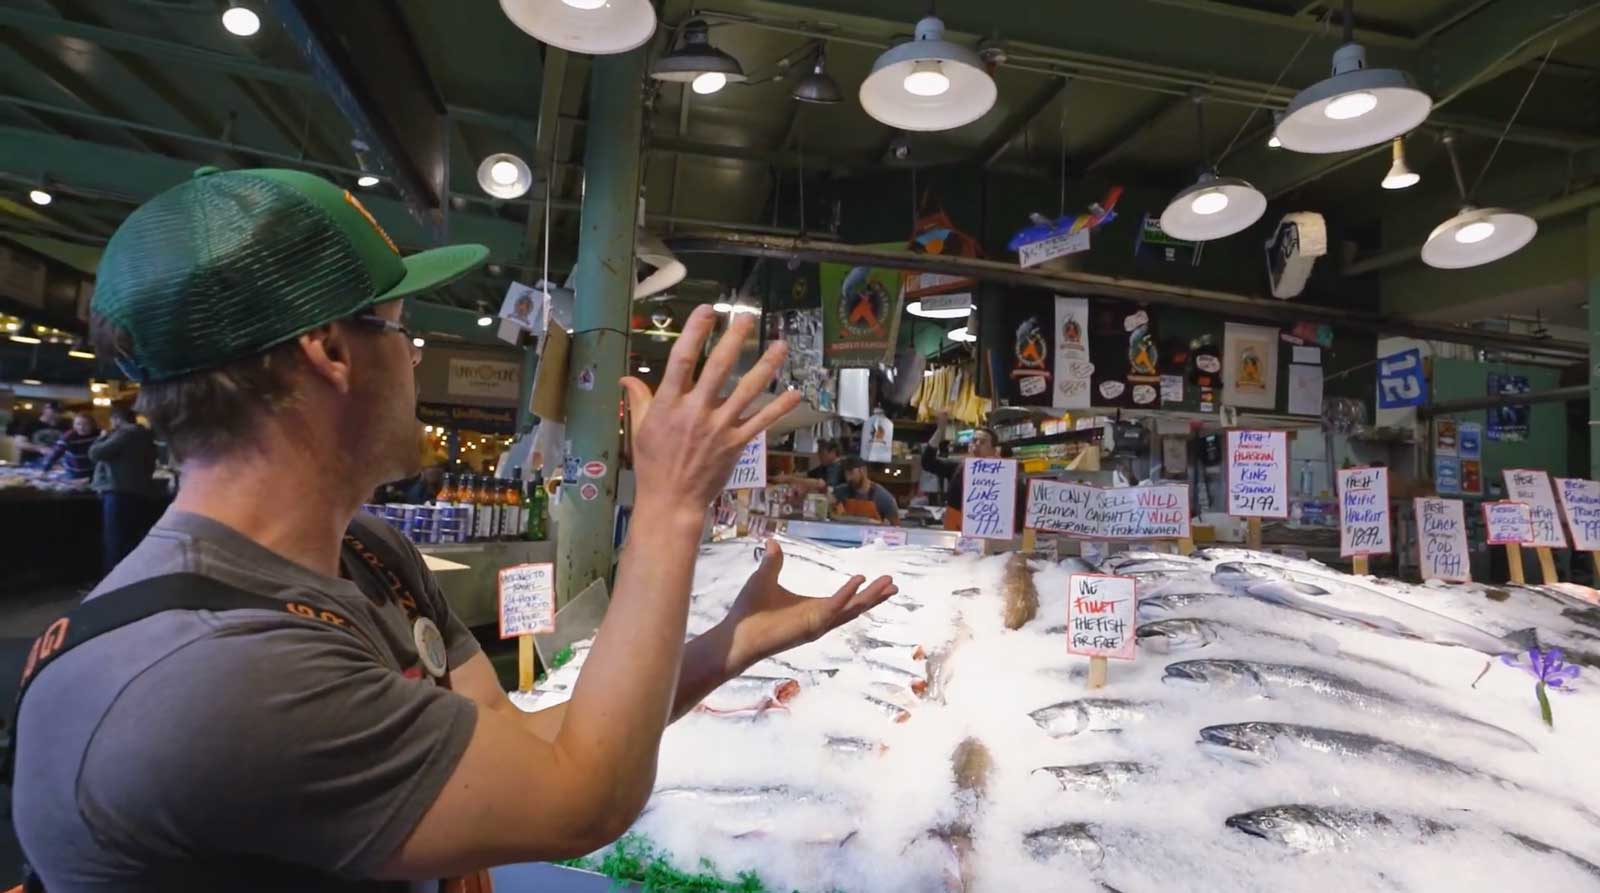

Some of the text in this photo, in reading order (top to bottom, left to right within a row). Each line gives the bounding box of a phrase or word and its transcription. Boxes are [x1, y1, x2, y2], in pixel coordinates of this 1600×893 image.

[1381, 355, 1421, 402] 12
[970, 460, 1006, 474] FRESH
[1240, 468, 1268, 481] KING
[967, 486, 1000, 502] LING
[1033, 483, 1177, 509] WE ONLY SELL WILD
[1231, 483, 1276, 494] SALMON
[1344, 491, 1376, 506] PACIFIC
[973, 502, 999, 515] COD
[1029, 504, 1078, 518] SALMON
[1085, 508, 1130, 522] CAUGHT
[1147, 507, 1183, 524] WILD
[1424, 501, 1450, 514] FRESH
[1034, 516, 1099, 534] FISHERMEN
[1344, 509, 1384, 525] HALIBUT
[1424, 513, 1457, 533] BLACK
[1427, 539, 1453, 553] COD
[1079, 579, 1102, 595] WE
[1074, 596, 1124, 613] FILLET
[1071, 616, 1127, 633] THE FISH
[1073, 633, 1094, 647] FOR
